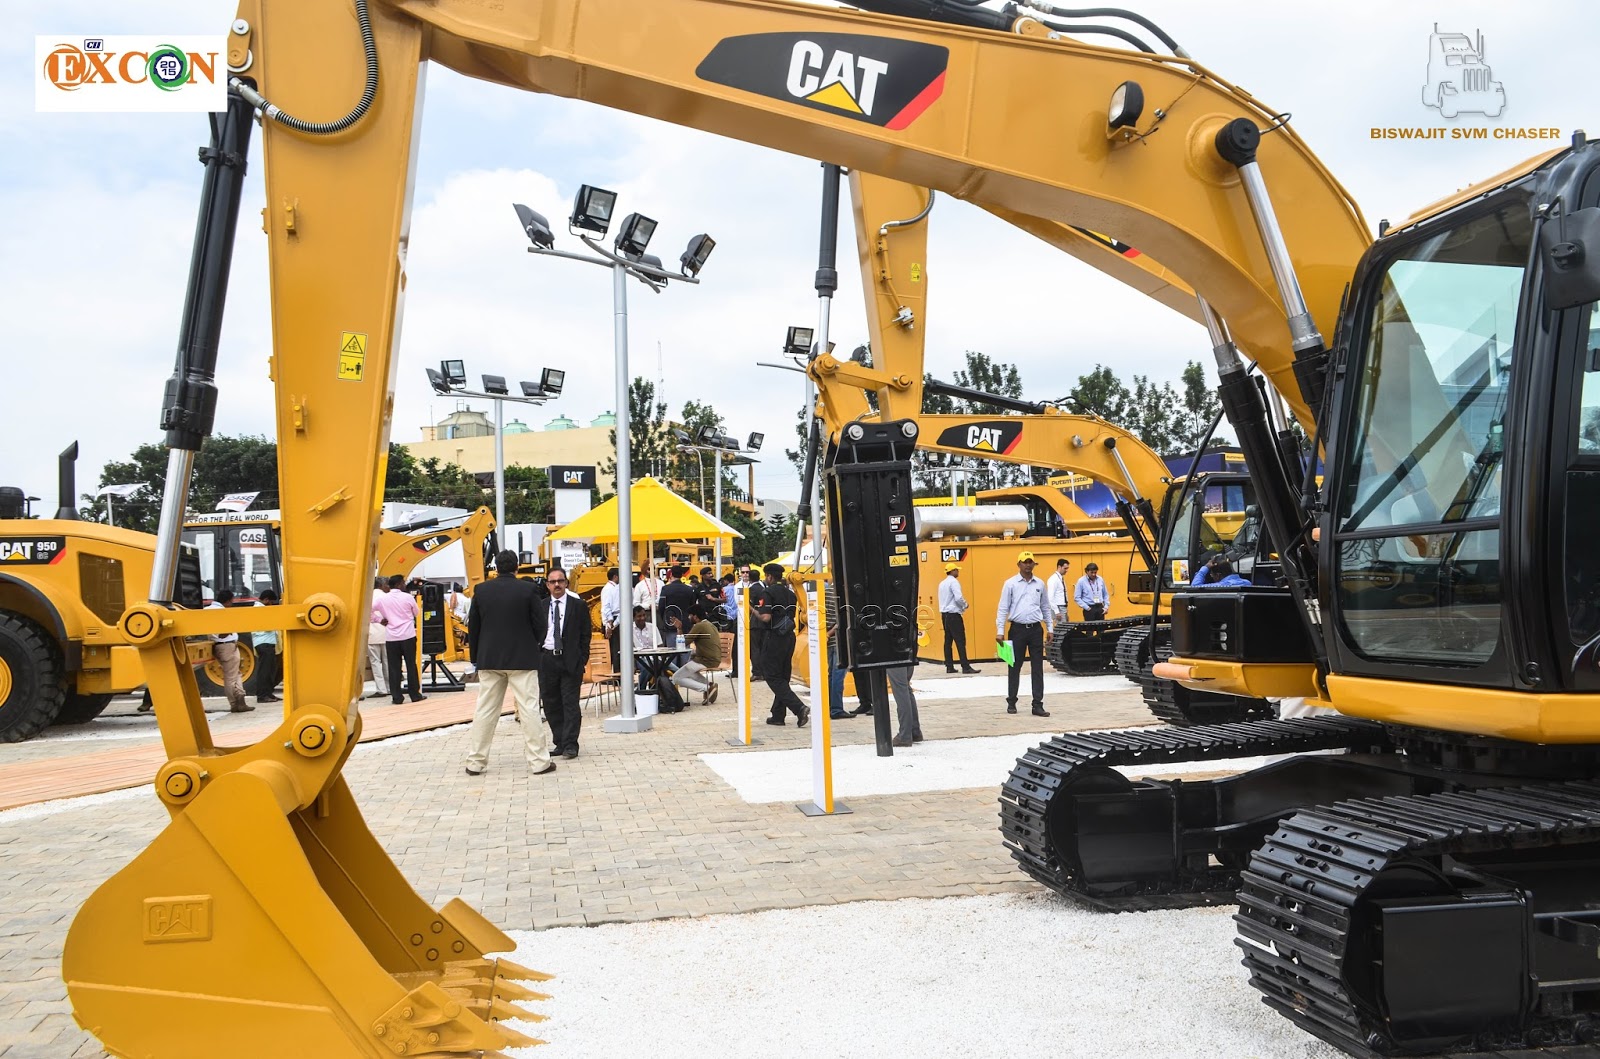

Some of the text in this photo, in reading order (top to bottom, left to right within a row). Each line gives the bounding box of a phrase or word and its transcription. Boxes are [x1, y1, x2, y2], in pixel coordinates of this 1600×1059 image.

[786, 39, 889, 117] CAT
[966, 425, 1003, 452] CAT
[563, 471, 585, 484] CAT
[0, 542, 34, 560] CAT
[36, 542, 57, 551] 950
[423, 537, 440, 551] CAT
[942, 549, 961, 562] CAT
[148, 903, 204, 936] CAT
